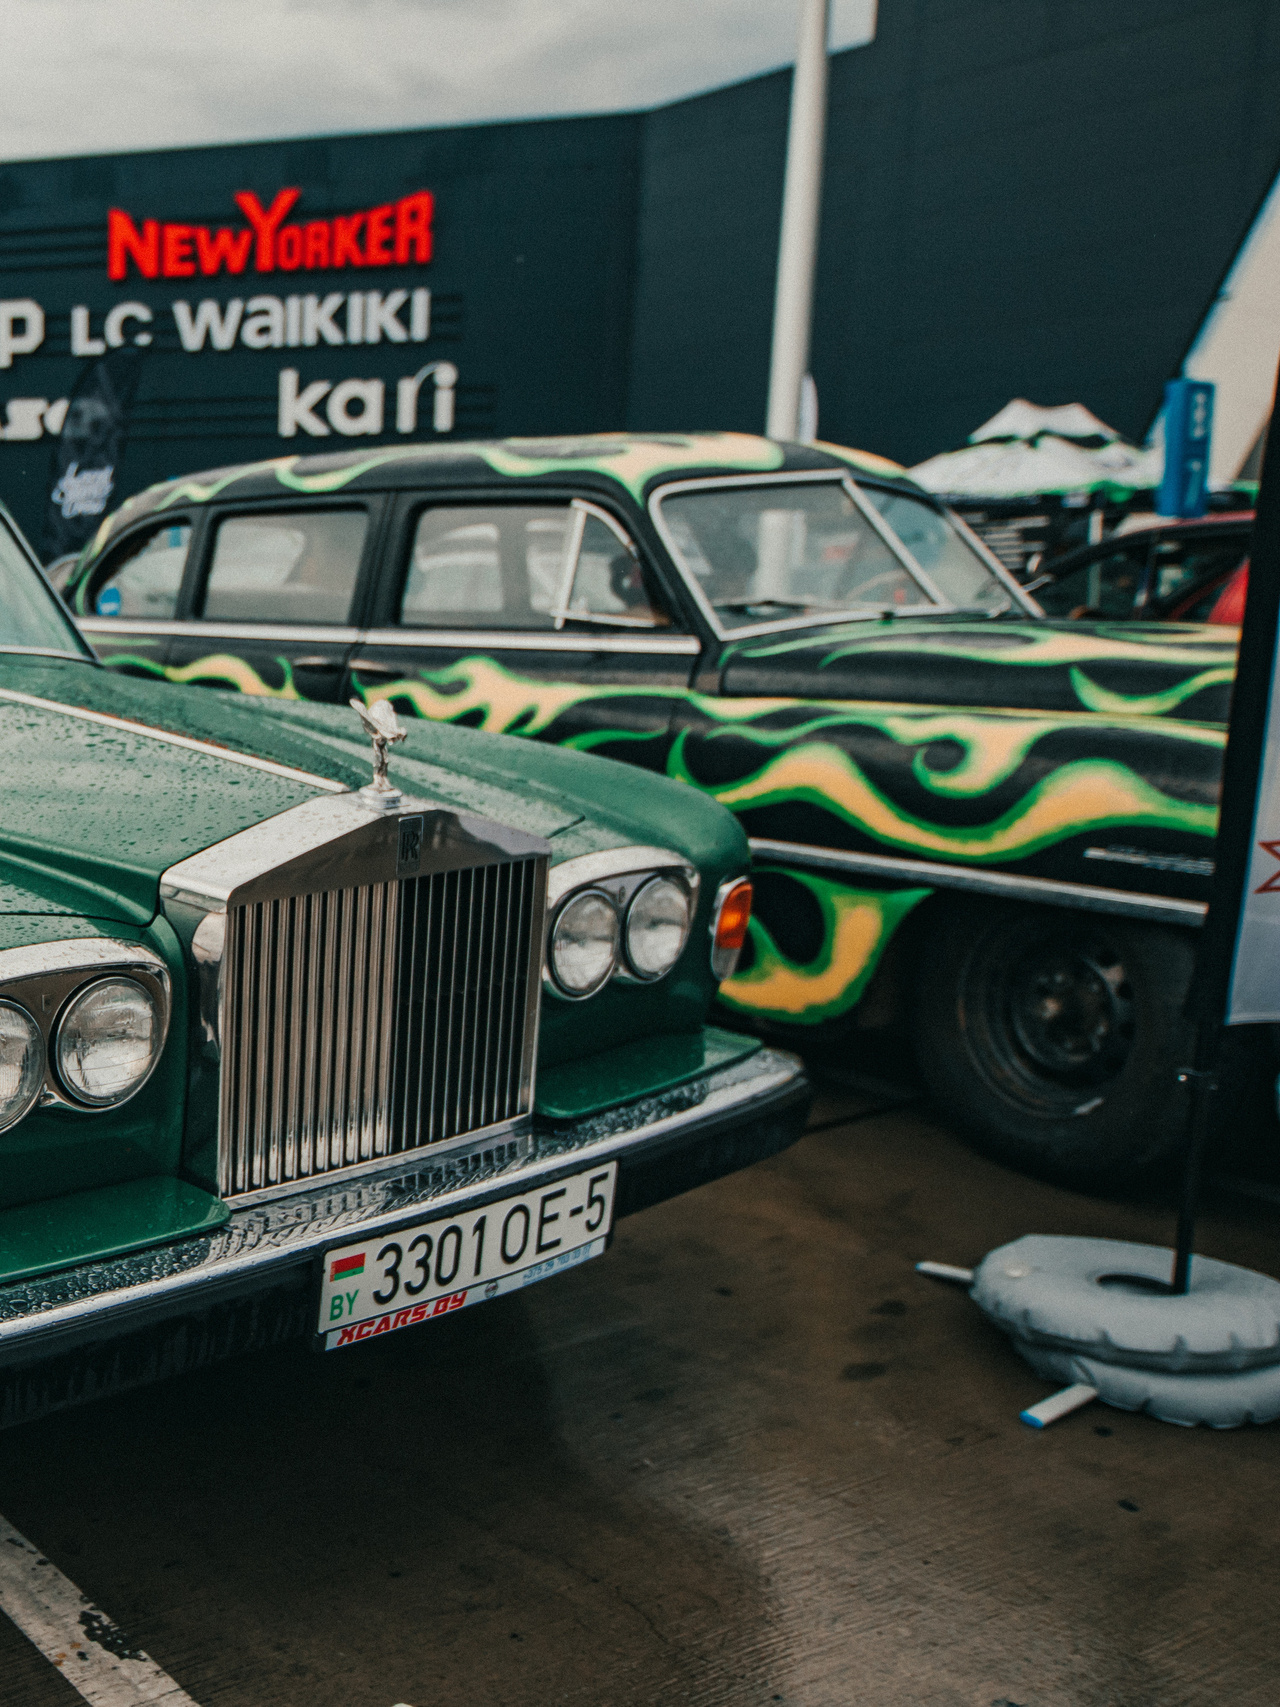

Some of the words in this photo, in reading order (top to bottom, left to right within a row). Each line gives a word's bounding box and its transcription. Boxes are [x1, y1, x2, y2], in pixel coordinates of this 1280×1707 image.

[71, 301, 153, 356] LC
[278, 360, 459, 438] kari
[372, 1215, 487, 1305] 3301
[500, 1171, 610, 1265] OE-5
[329, 1289, 359, 1321] BY
[336, 1290, 468, 1346] XCARS.BY
